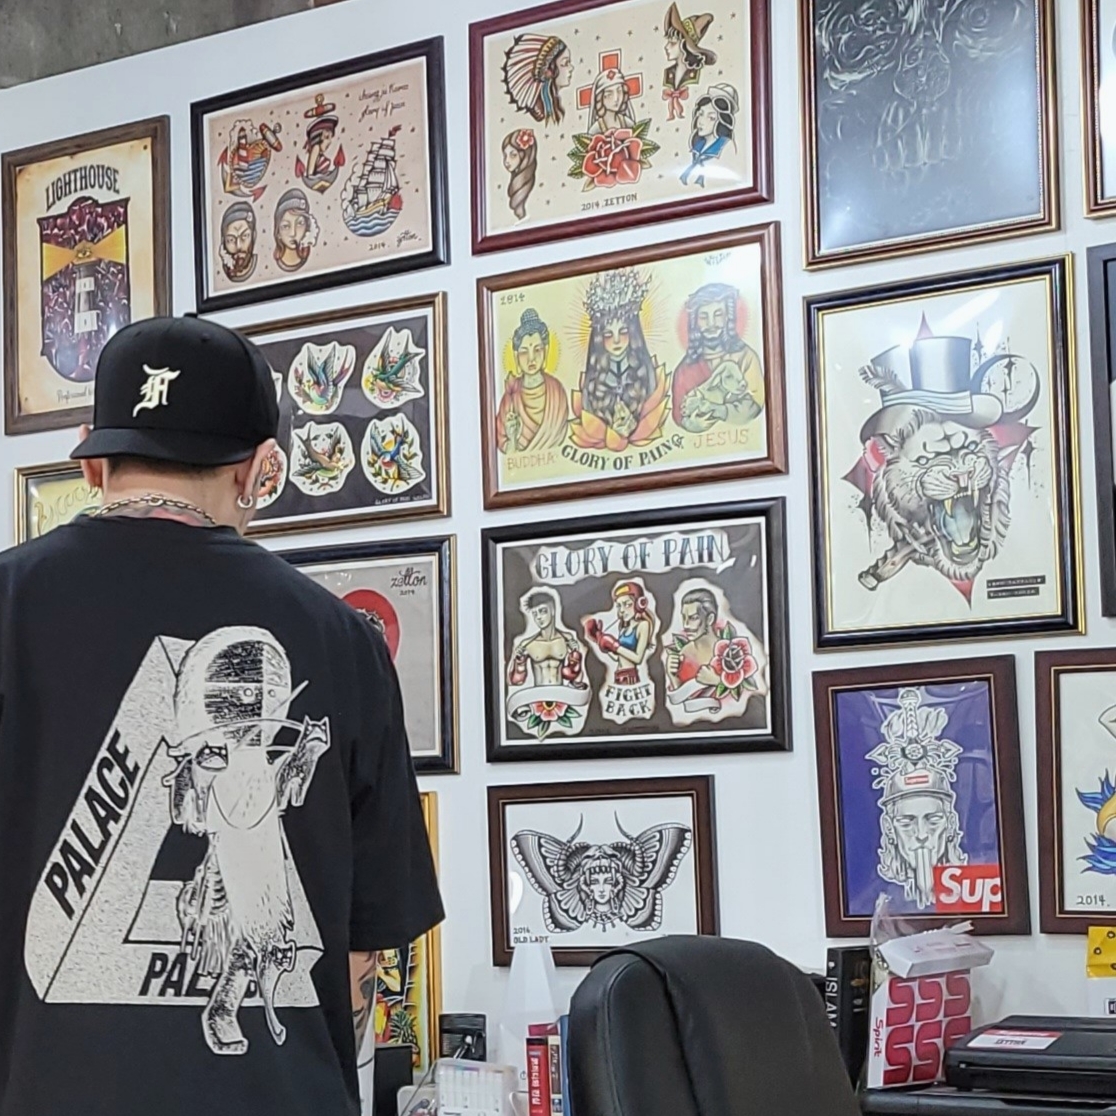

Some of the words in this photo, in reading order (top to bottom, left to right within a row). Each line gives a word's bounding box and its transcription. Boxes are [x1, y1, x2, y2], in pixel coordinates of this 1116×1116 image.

[45, 163, 120, 212] LIGHTHOUSE
[604, 193, 637, 207] ZETTON
[693, 429, 750, 449] JESUS
[506, 452, 556, 471] BUDDHA
[561, 444, 610, 471] GLORY
[612, 455, 634, 471] OF
[536, 544, 613, 580] GLORY
[621, 540, 653, 570] OF
[663, 534, 726, 568] PAIN
[604, 685, 652, 699] FIGHT
[605, 700, 652, 716] BACK
[44, 728, 141, 920] PALACE
[939, 867, 1002, 912] Sup
[513, 936, 527, 944] OLD
[529, 935, 550, 944] LADY
